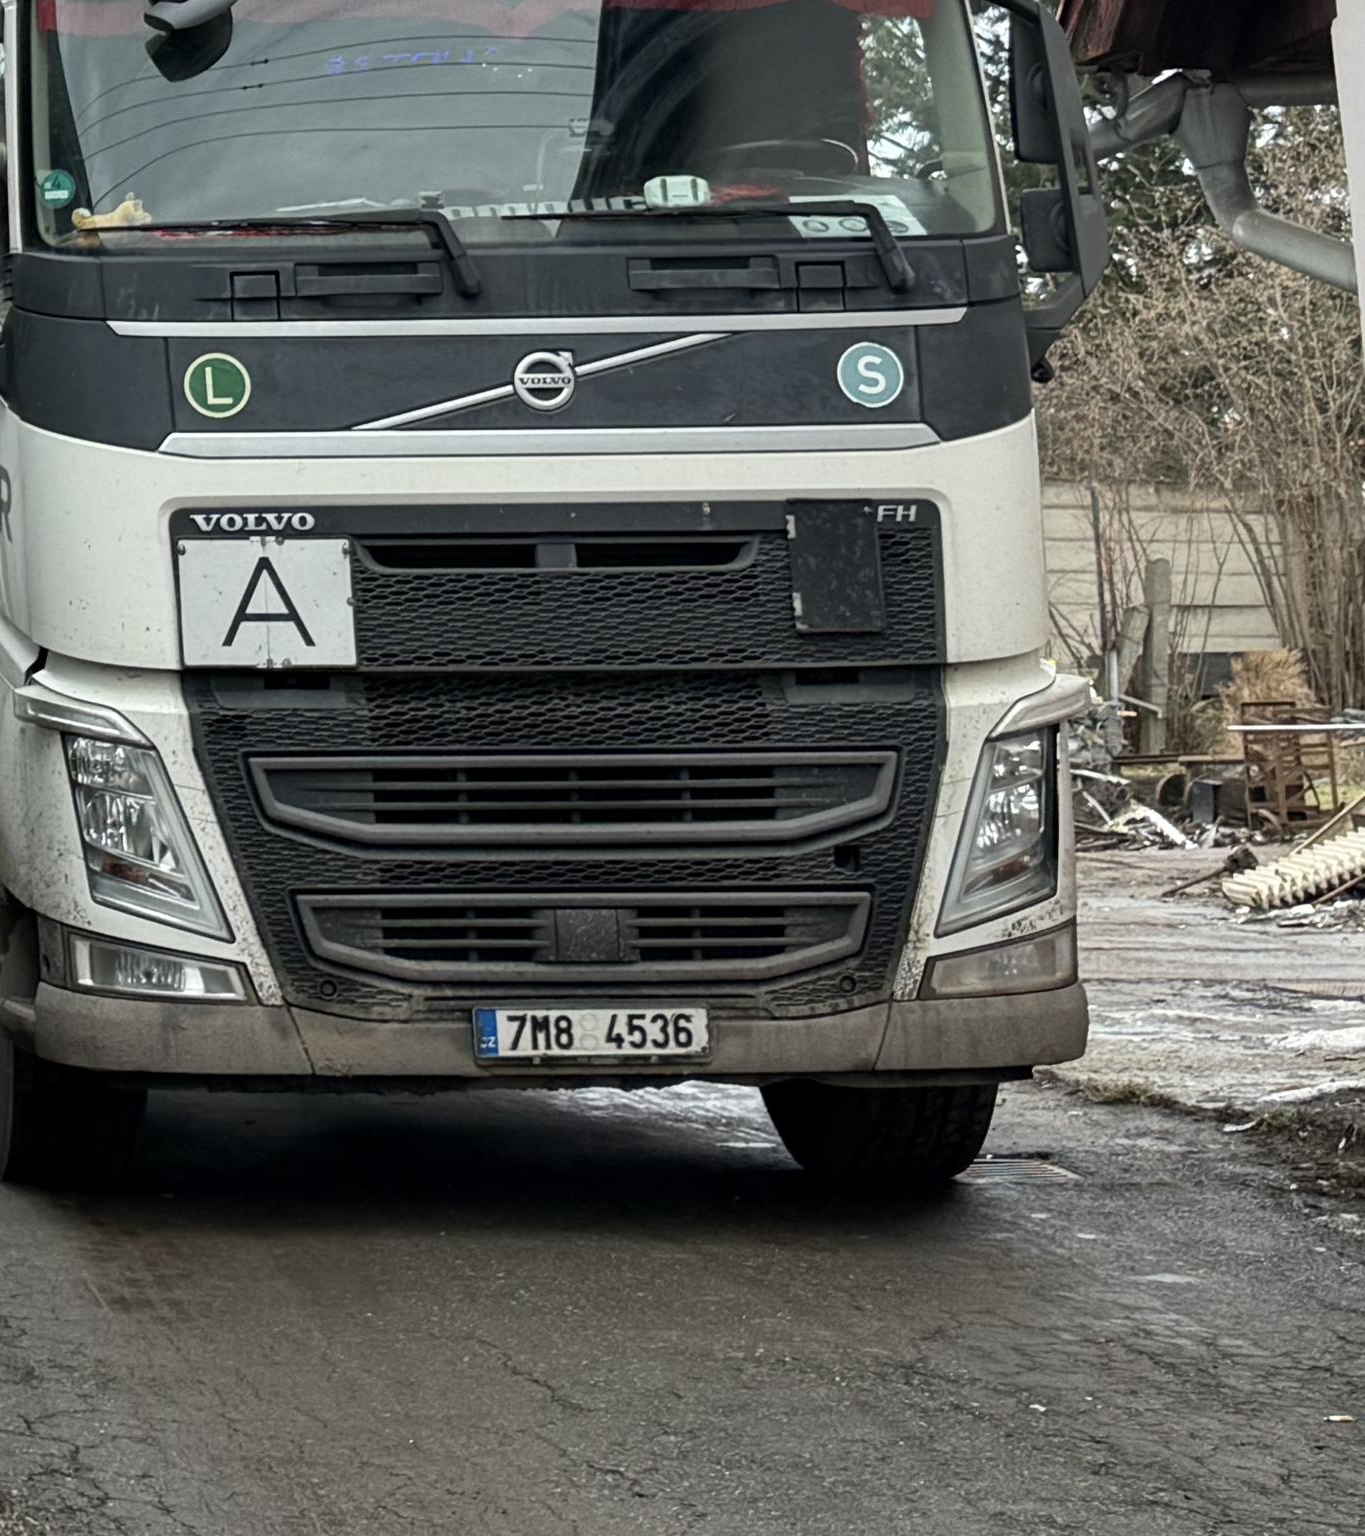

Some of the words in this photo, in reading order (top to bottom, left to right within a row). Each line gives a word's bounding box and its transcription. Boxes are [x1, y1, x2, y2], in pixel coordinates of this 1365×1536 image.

[205, 366, 234, 405] L
[518, 376, 572, 385] VOLVO
[856, 355, 887, 394] S
[190, 512, 316, 532] VOLVO
[876, 504, 918, 523] FH
[221, 556, 316, 647] A
[506, 1014, 574, 1052] 7M8
[604, 1013, 694, 1050] 4536
